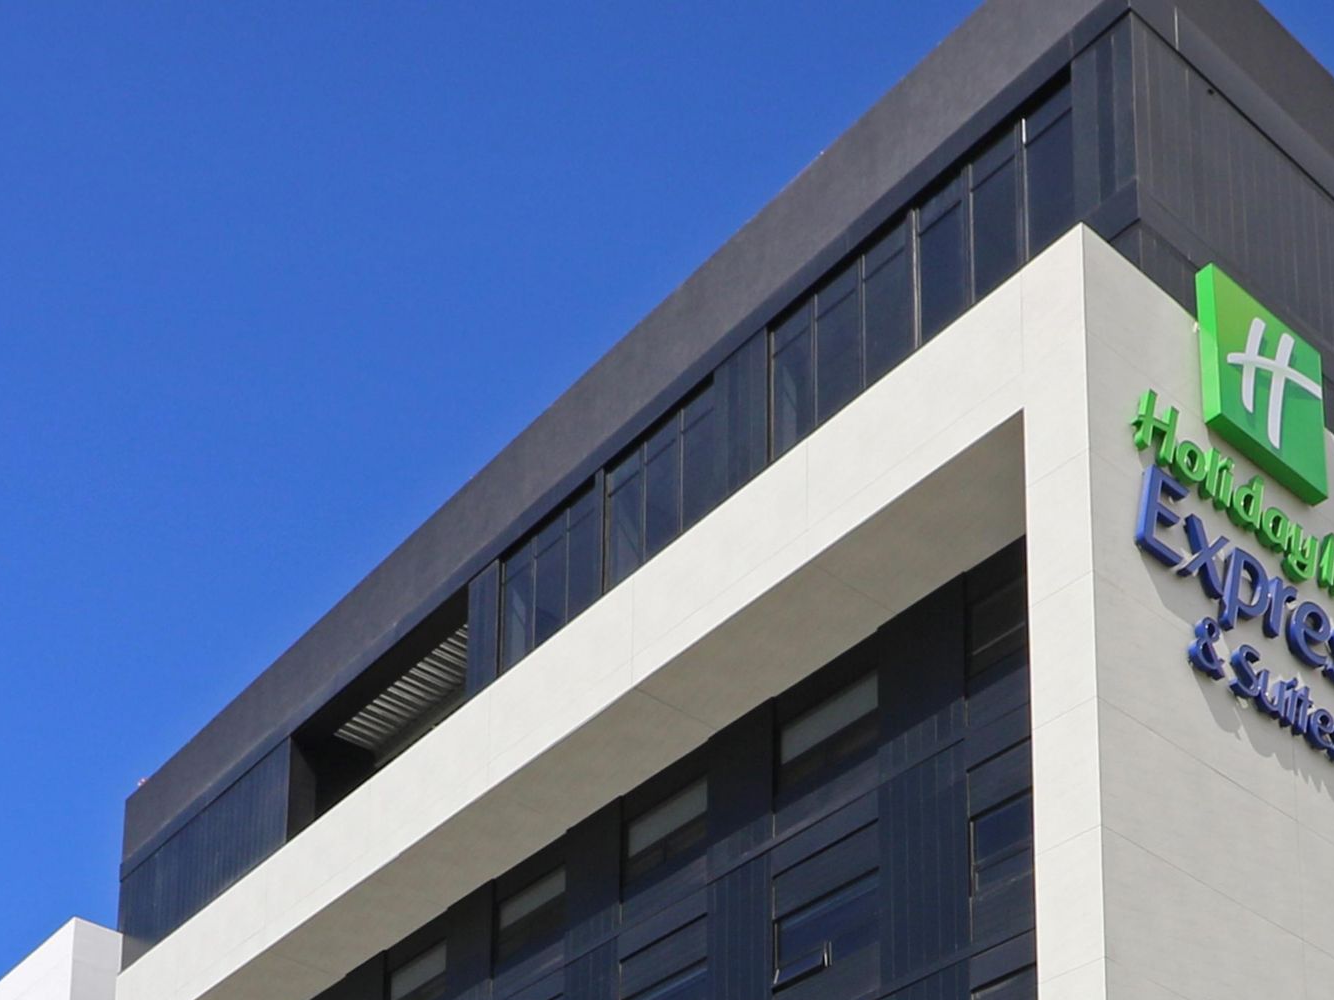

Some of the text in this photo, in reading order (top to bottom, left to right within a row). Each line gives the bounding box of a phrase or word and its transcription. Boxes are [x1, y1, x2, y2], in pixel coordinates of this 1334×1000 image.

[1226, 316, 1323, 450] H
[1130, 388, 1319, 583] Holiday
[1187, 616, 1225, 681] &
